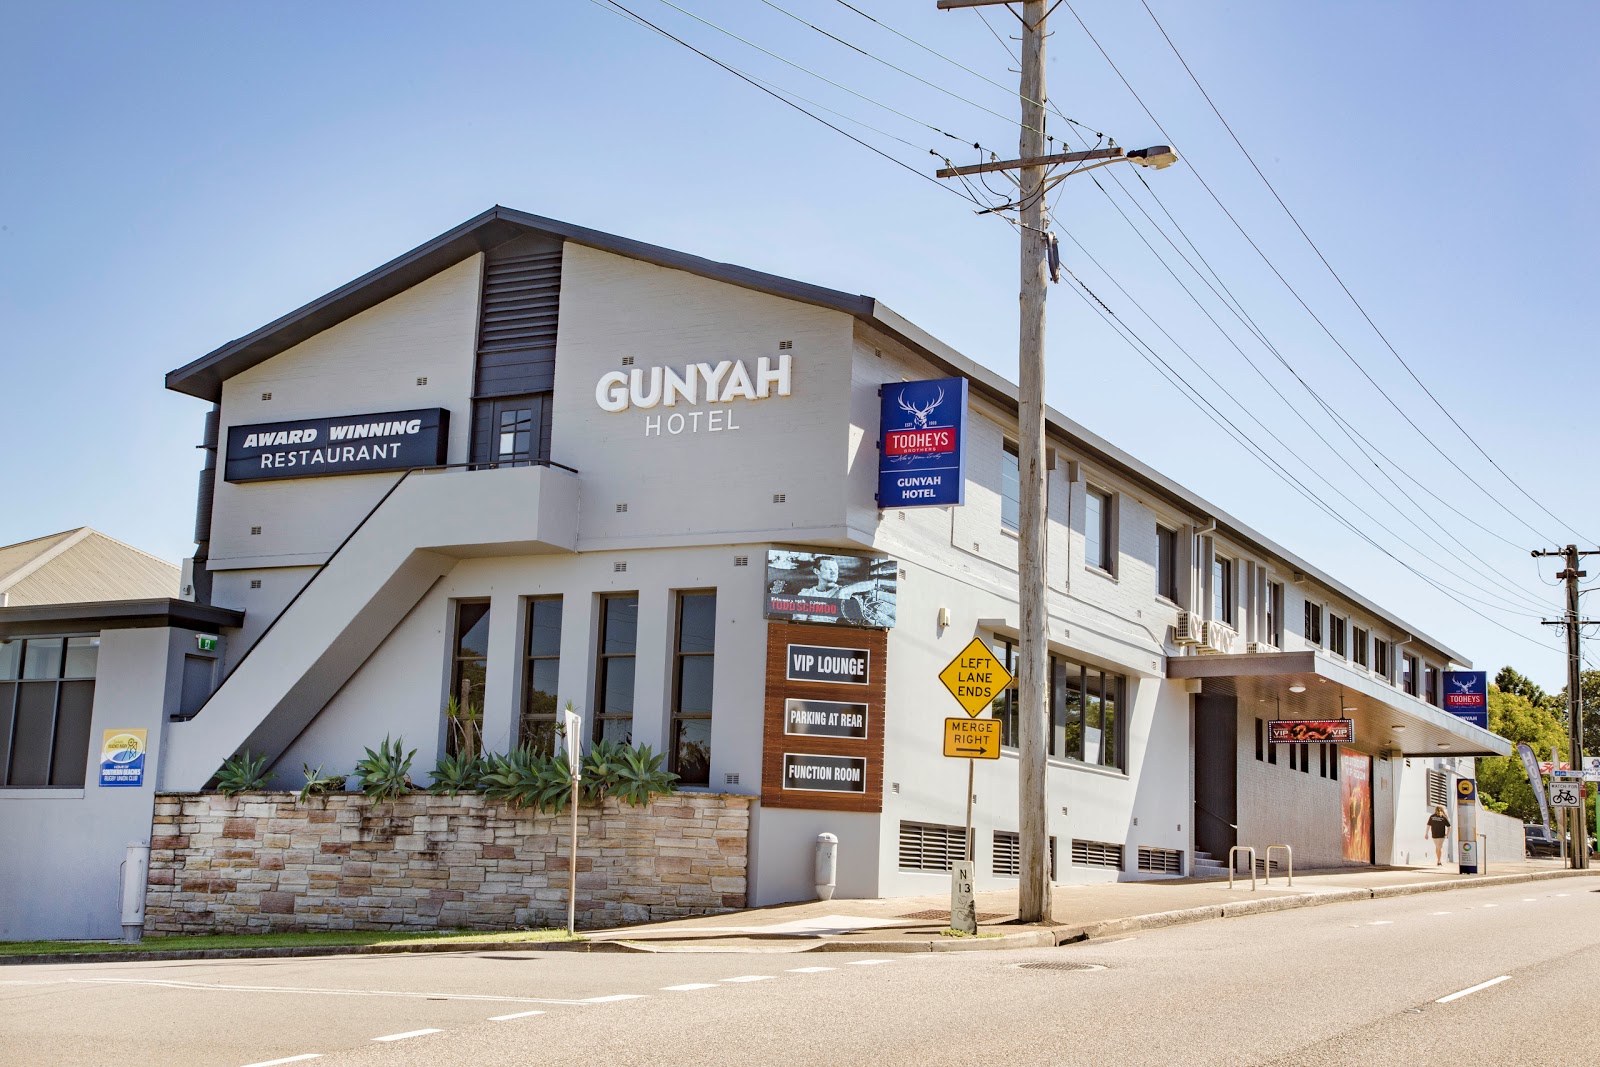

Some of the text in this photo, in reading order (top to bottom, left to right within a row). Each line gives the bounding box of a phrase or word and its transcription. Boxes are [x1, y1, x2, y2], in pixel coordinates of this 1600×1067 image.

[595, 354, 793, 413] GUNYAH
[645, 409, 740, 437] HOTEL
[243, 419, 422, 448] AWARD WINNING
[892, 431, 949, 449] TOOHEYS
[260, 442, 402, 468] RESTAURANT
[897, 476, 941, 487] GUNYAH
[902, 489, 936, 499] HOTEL
[771, 599, 796, 611] TODD
[793, 653, 865, 676] VIP LOUNGE
[960, 658, 992, 669] LEFT
[958, 671, 992, 683] LANE
[957, 685, 992, 697] ENDS
[1449, 695, 1481, 703] TOOHEYS
[790, 710, 863, 728] PARKING AT REAR
[951, 722, 993, 733] MERGE
[954, 734, 990, 745] RIGHT
[788, 764, 861, 782] FUNCTION ROOM
[960, 869, 967, 880] N
[959, 884, 971, 893] 13
